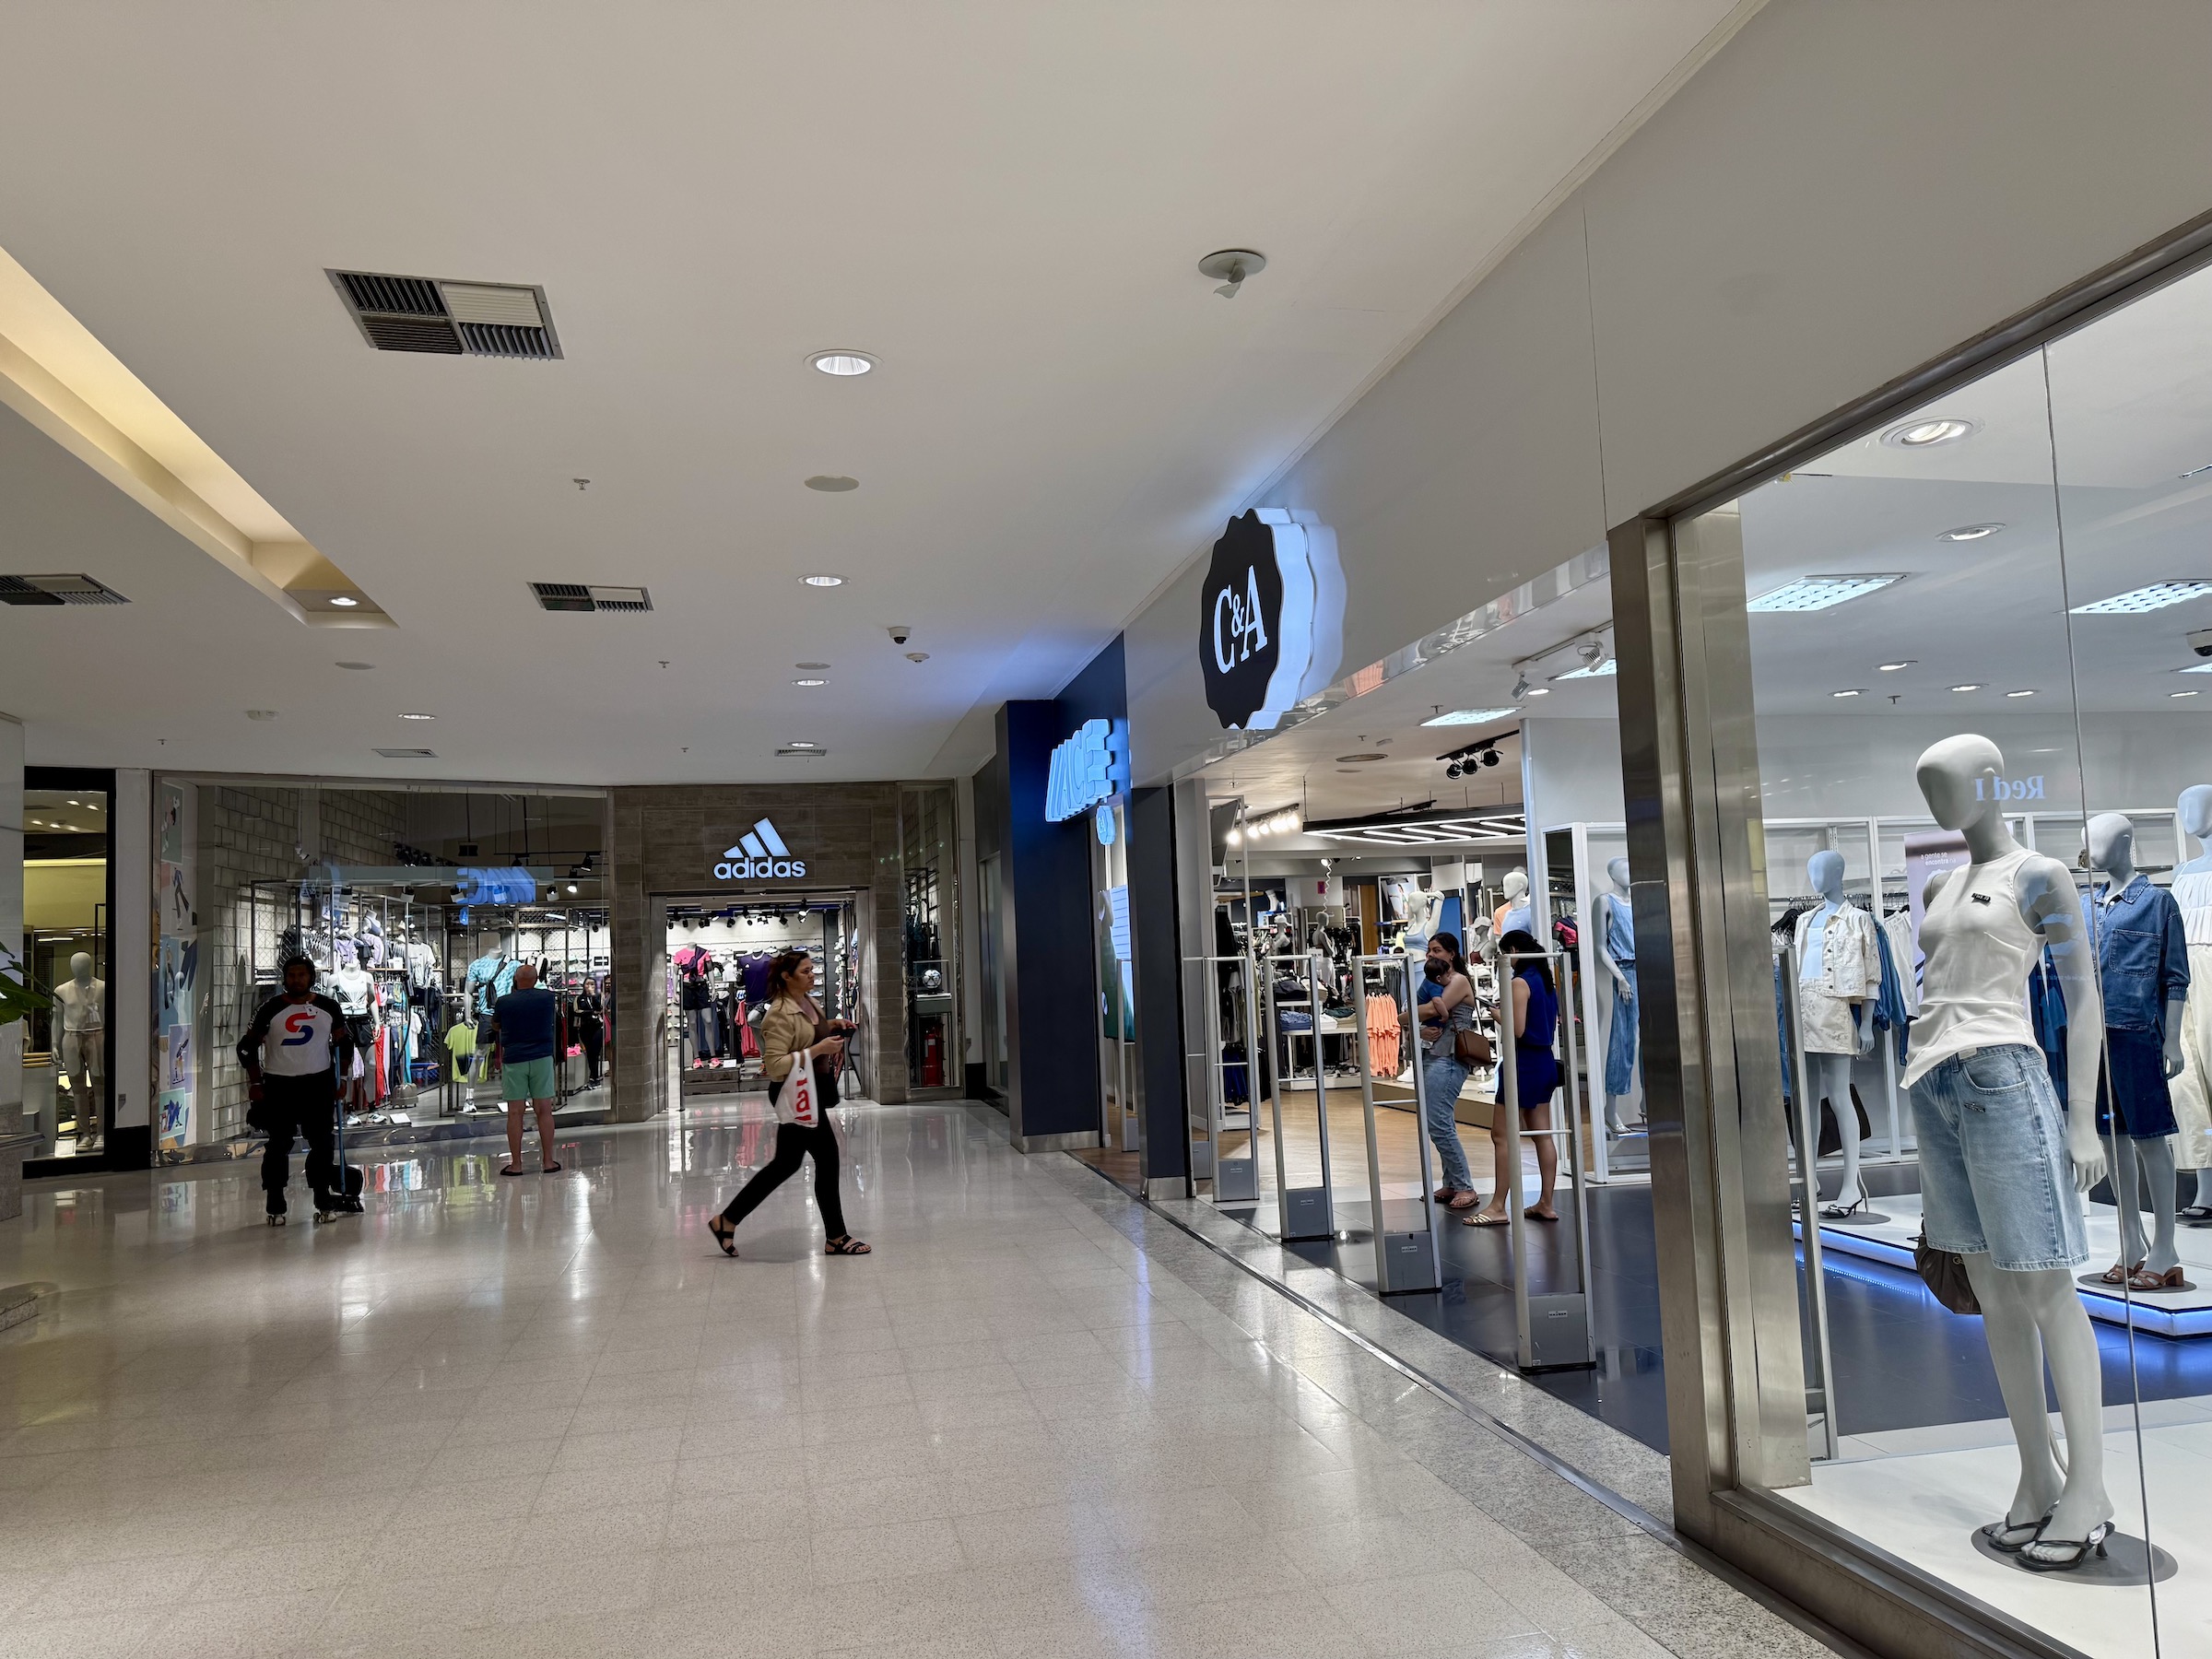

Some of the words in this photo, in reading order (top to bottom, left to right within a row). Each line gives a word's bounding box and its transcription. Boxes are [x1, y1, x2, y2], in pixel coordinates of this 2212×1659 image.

[1213, 564, 1268, 675] C&A
[1924, 852, 1940, 860] gente
[1924, 858, 1949, 866] encontra
[713, 856, 806, 880] adidas
